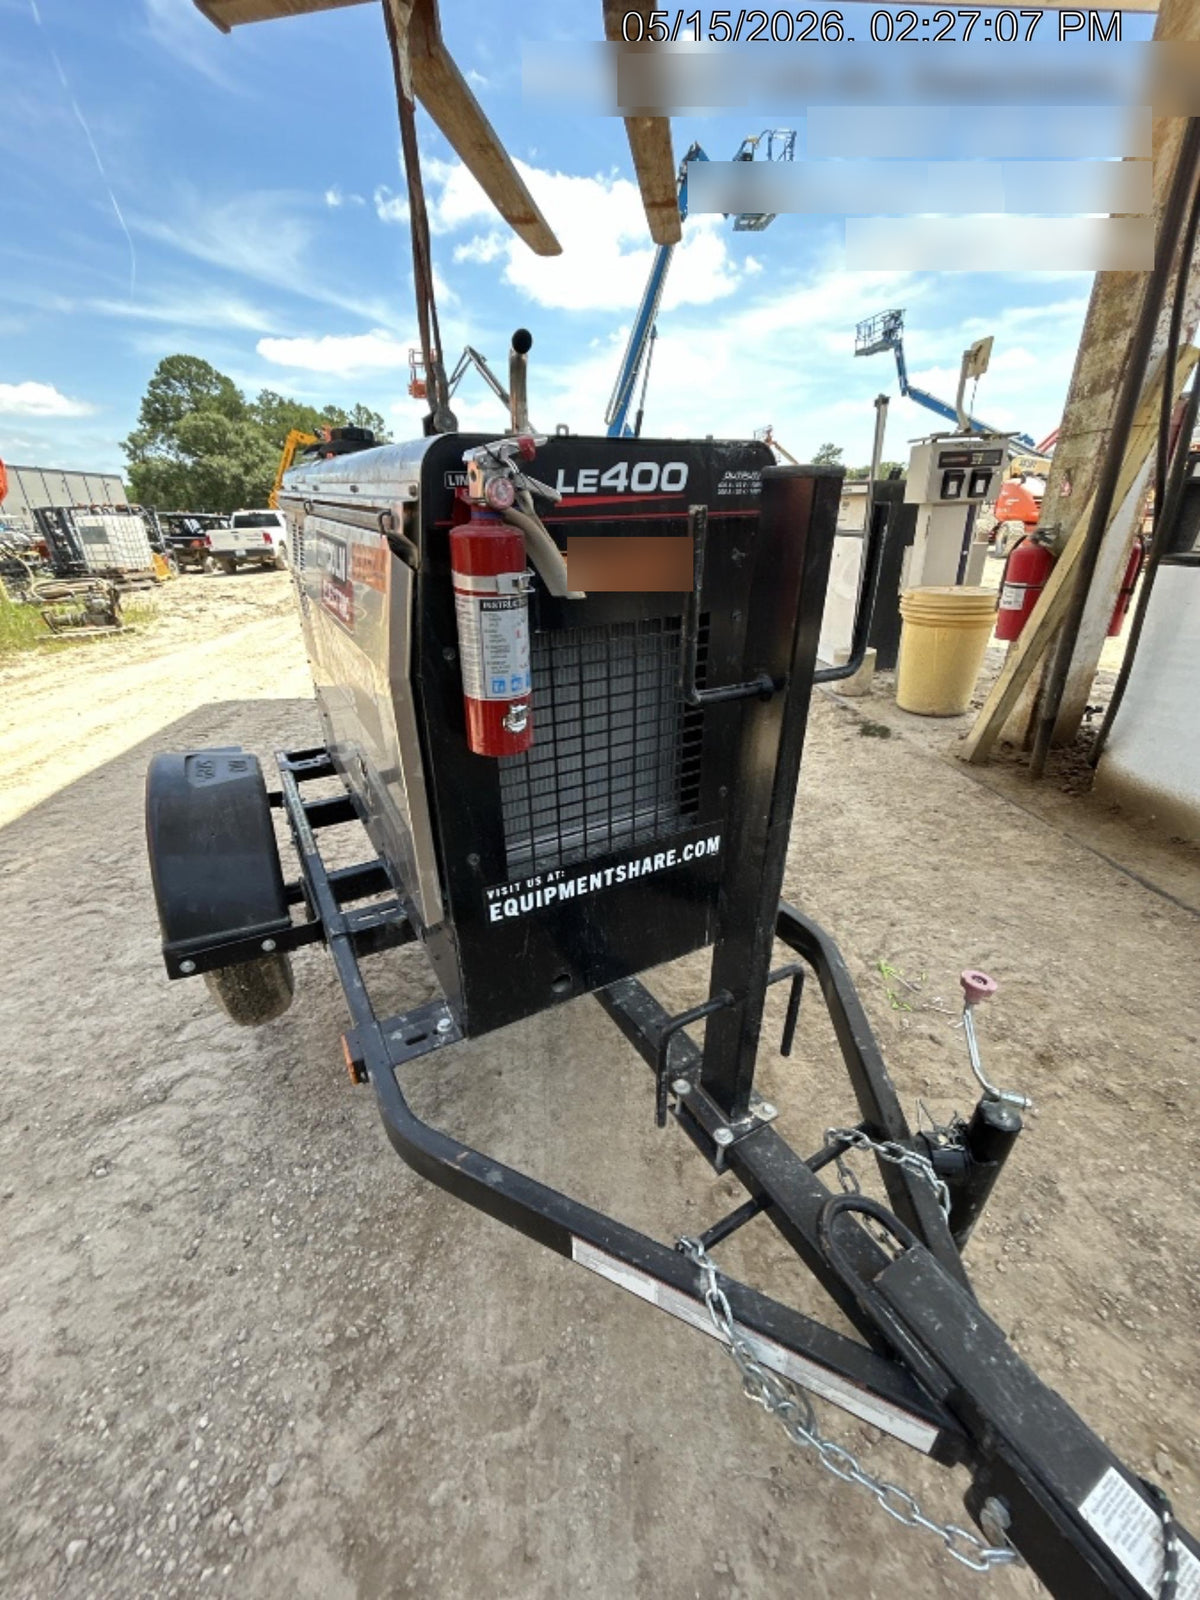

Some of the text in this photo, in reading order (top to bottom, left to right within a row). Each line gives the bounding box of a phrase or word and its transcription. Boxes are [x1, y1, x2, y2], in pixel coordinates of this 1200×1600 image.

[556, 461, 690, 494] LE400
[486, 870, 565, 900] VISIT US AT:
[489, 835, 721, 922] EQUIPMENTSHARE.COM
